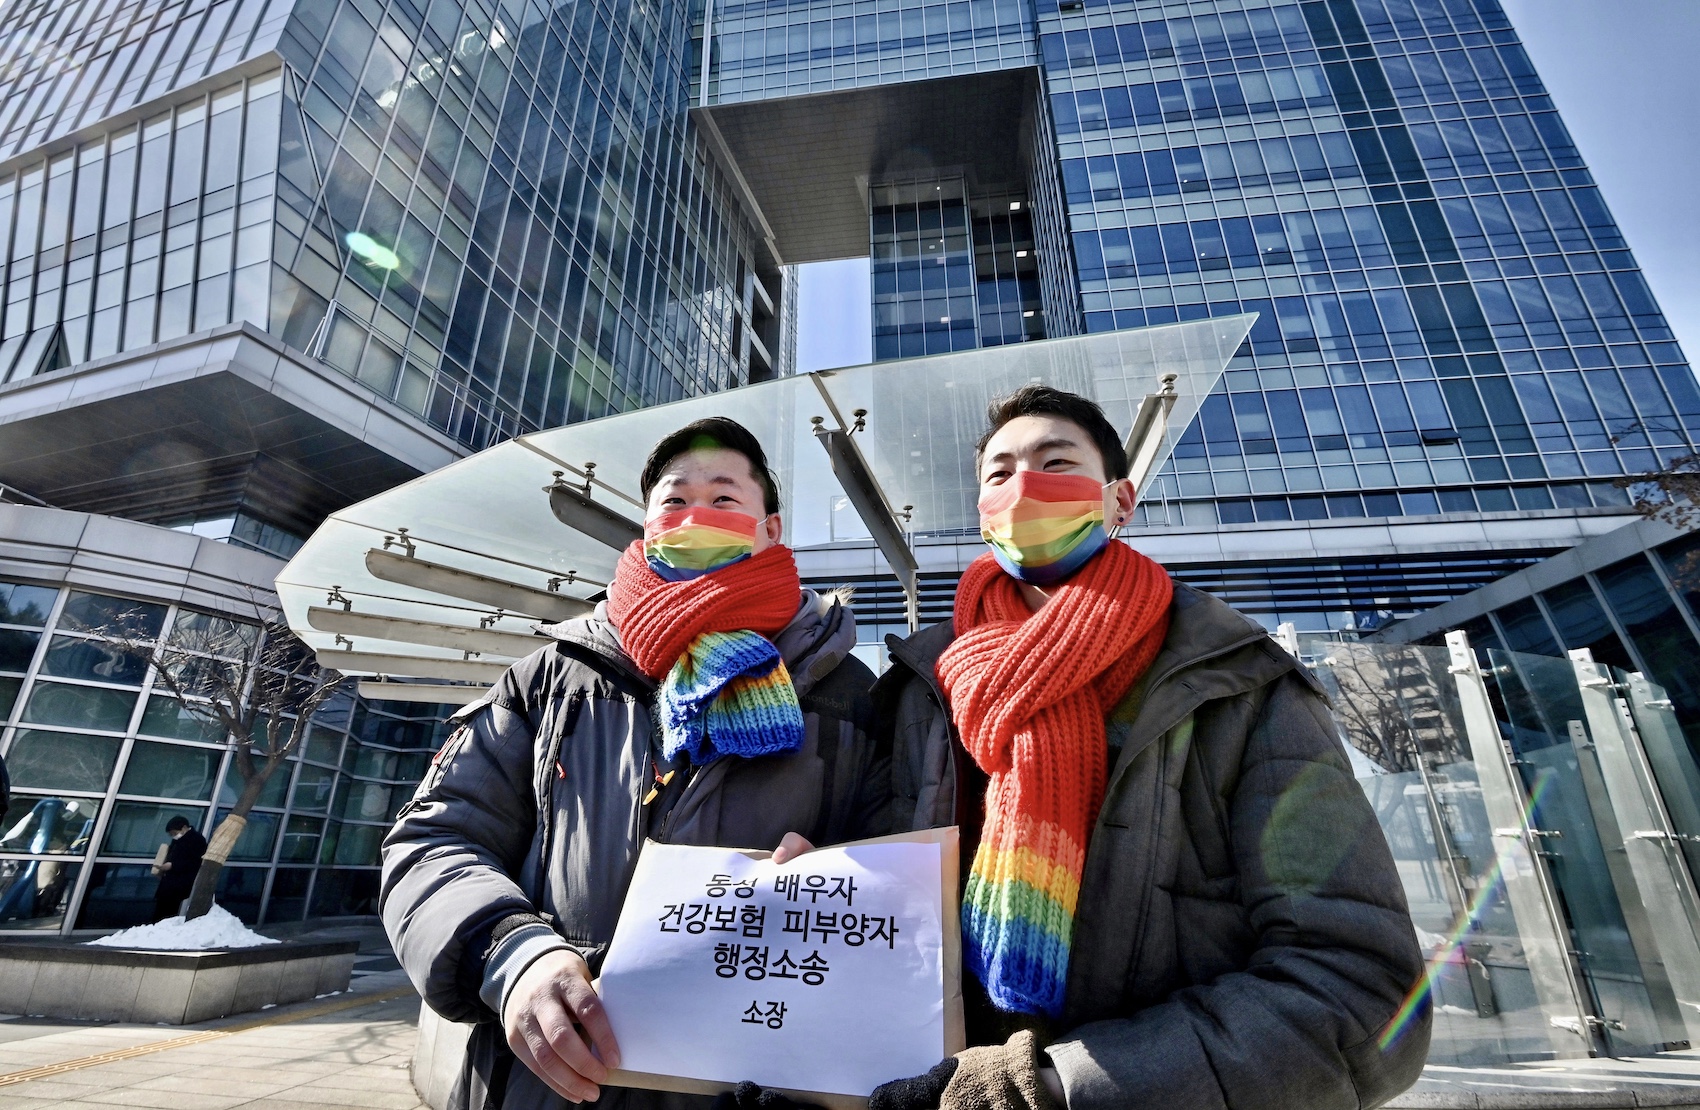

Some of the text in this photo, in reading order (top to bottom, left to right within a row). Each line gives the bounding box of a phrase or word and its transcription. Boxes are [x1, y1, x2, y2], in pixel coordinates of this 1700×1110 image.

[705, 874, 857, 906] 동성 배우자
[659, 903, 899, 949] 건강보험 피부양자
[714, 942, 829, 985] 행정소송
[742, 1000, 787, 1029] 소장
